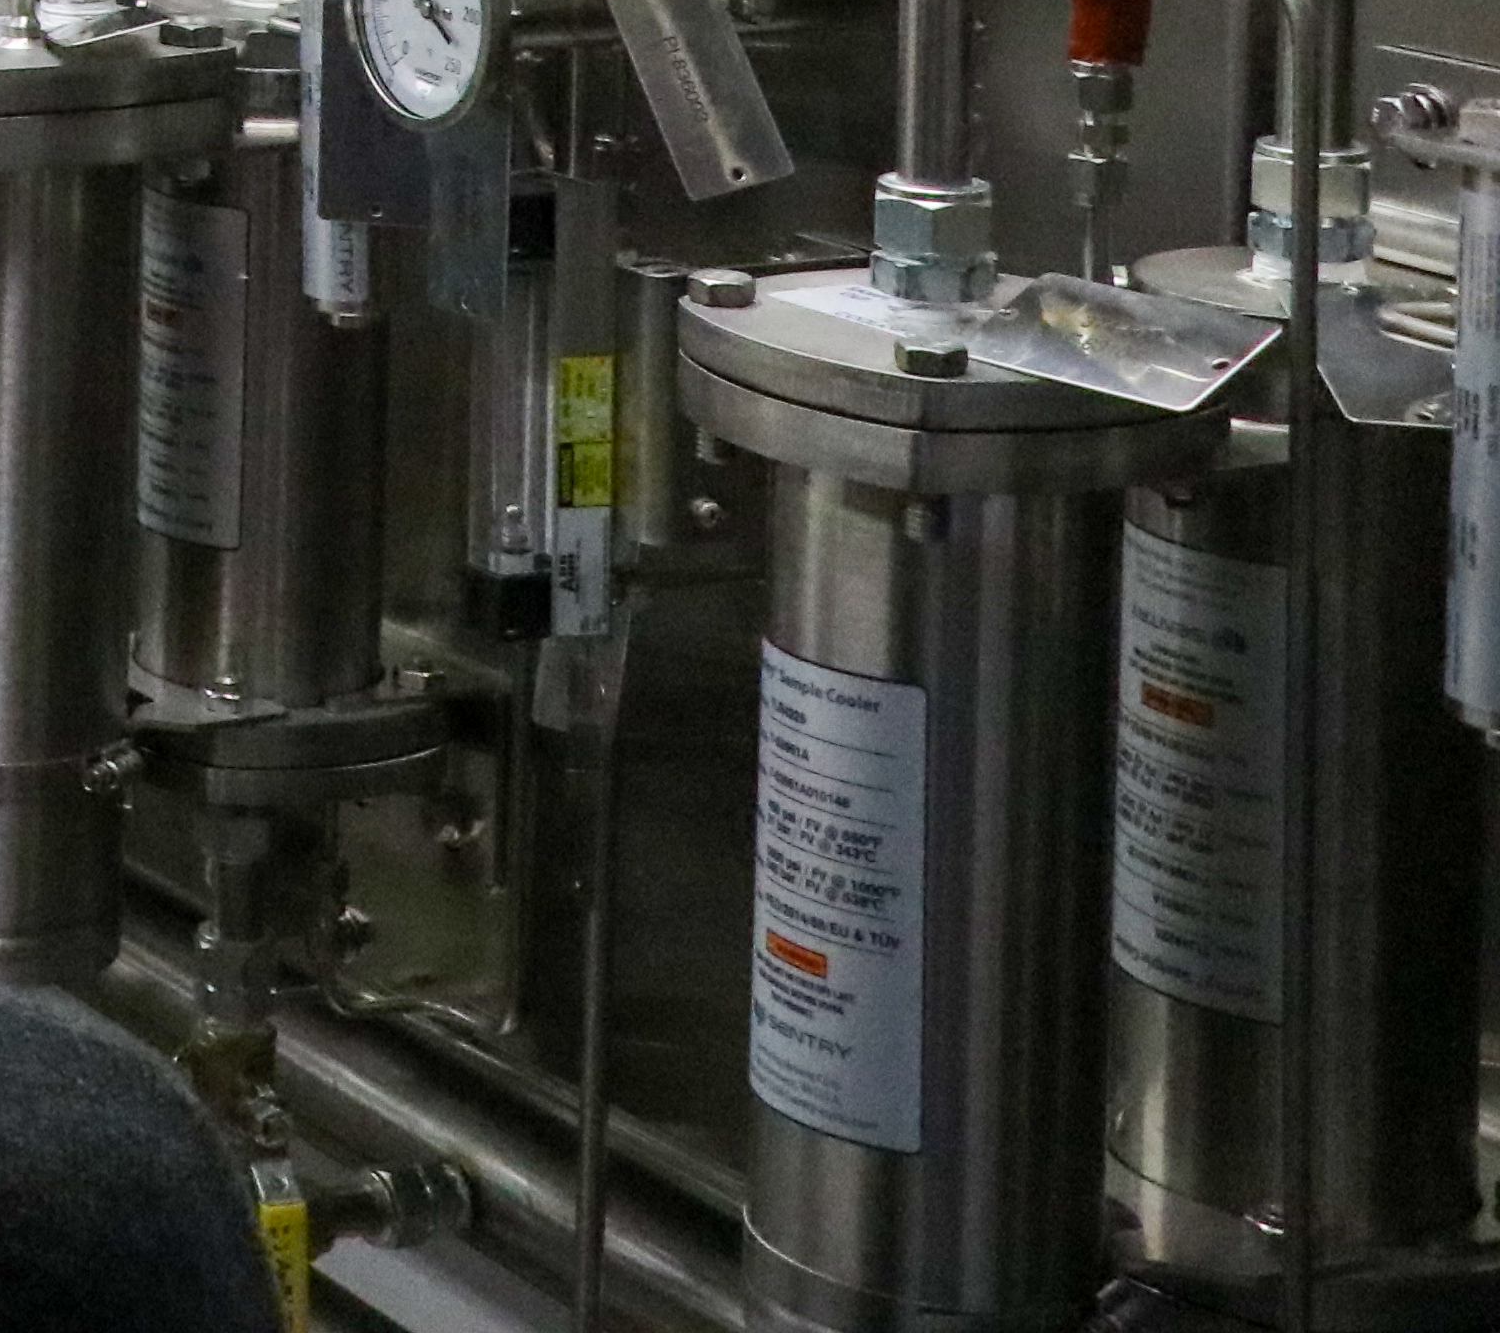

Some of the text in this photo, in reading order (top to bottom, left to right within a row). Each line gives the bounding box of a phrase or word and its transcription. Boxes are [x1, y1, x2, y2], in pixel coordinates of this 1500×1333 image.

[462, 6, 482, 26] 200
[444, 56, 462, 75] 250
[338, 222, 355, 295] NTRY
[558, 553, 577, 593] ABB
[826, 687, 881, 713] Cooler
[769, 1015, 852, 1060] SENTRY
